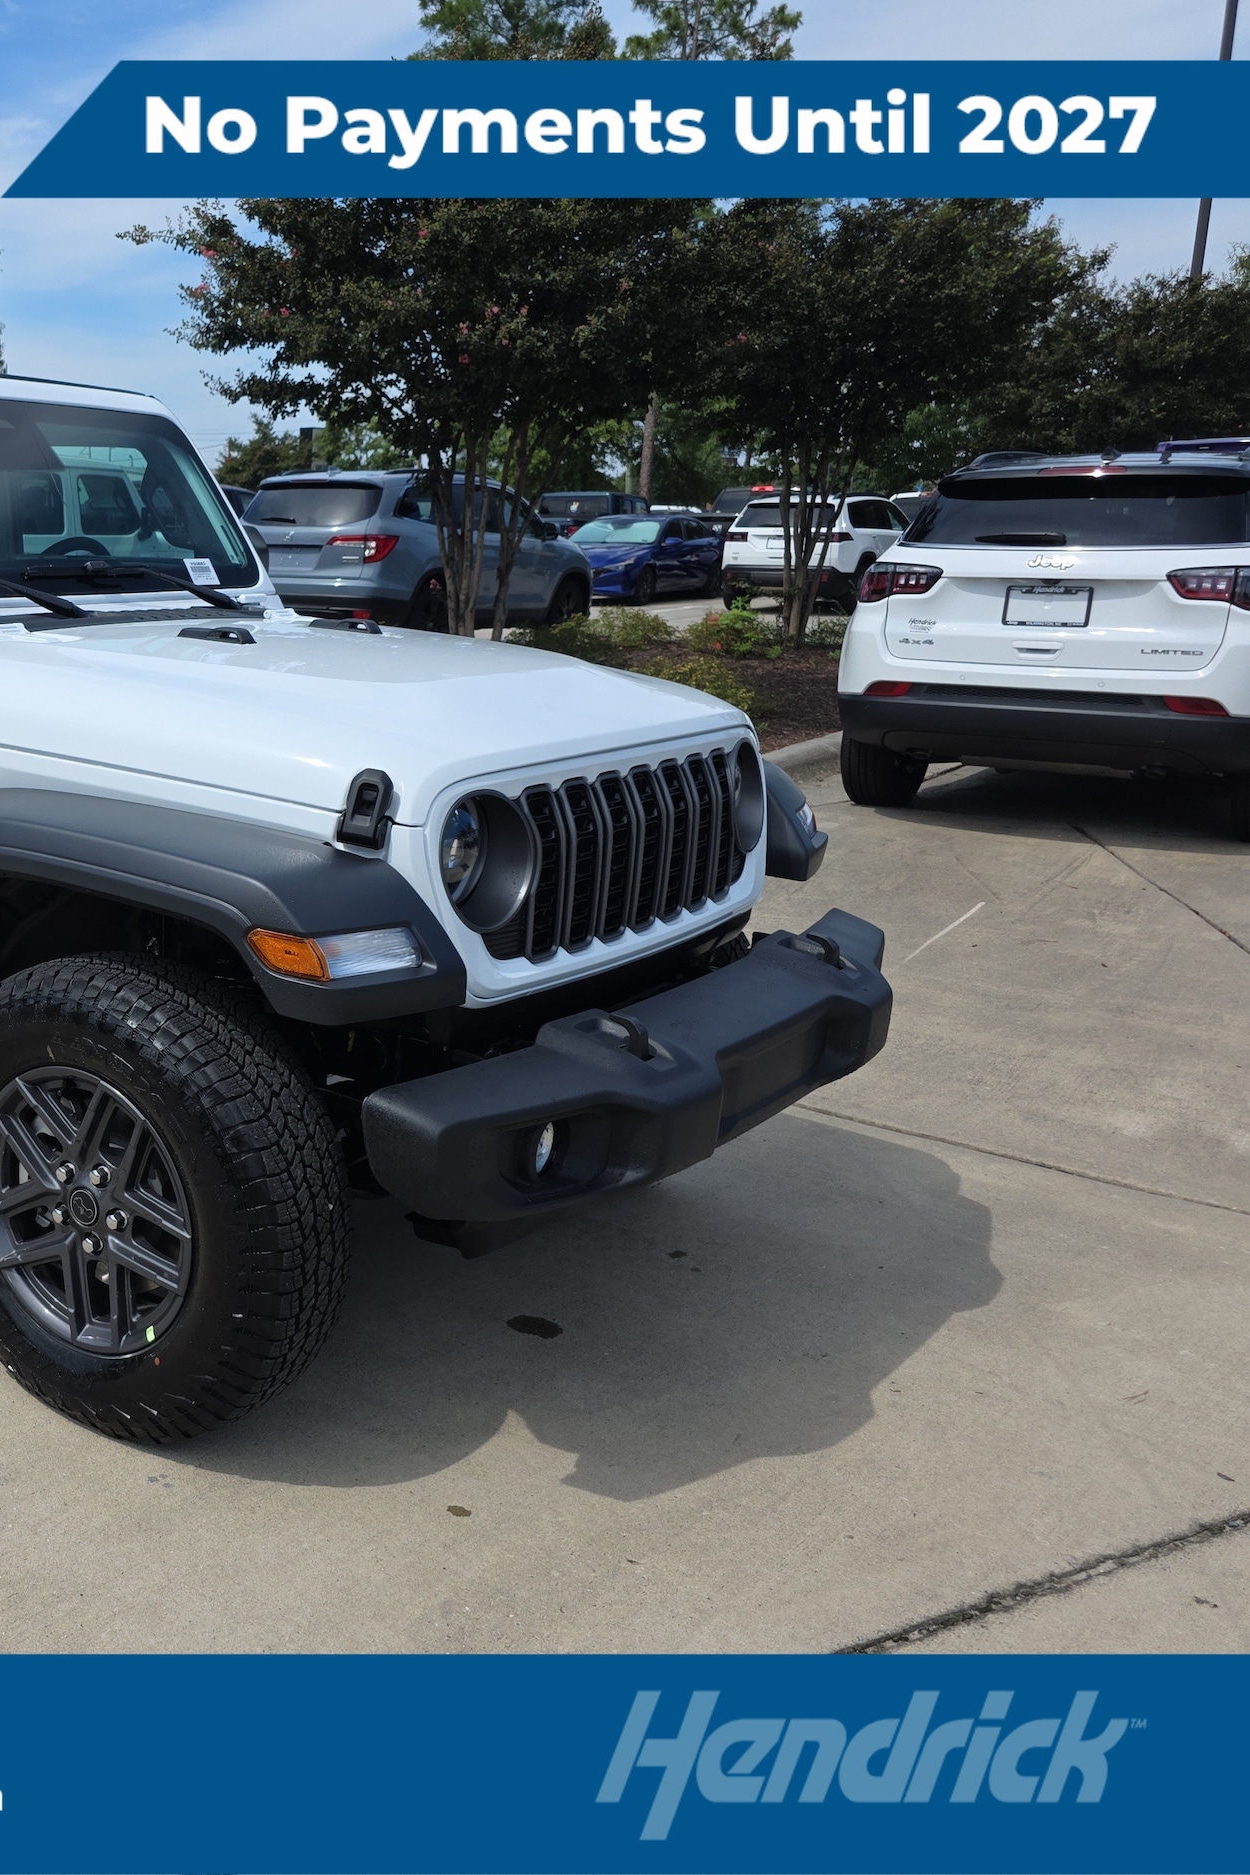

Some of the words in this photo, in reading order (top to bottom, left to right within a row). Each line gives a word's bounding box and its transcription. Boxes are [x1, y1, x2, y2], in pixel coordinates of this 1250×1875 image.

[1027, 554, 1075, 571] Jeep
[1032, 586, 1066, 594] Hendrick
[908, 617, 937, 626] Hendrick
[1141, 648, 1204, 656] LIMITED
